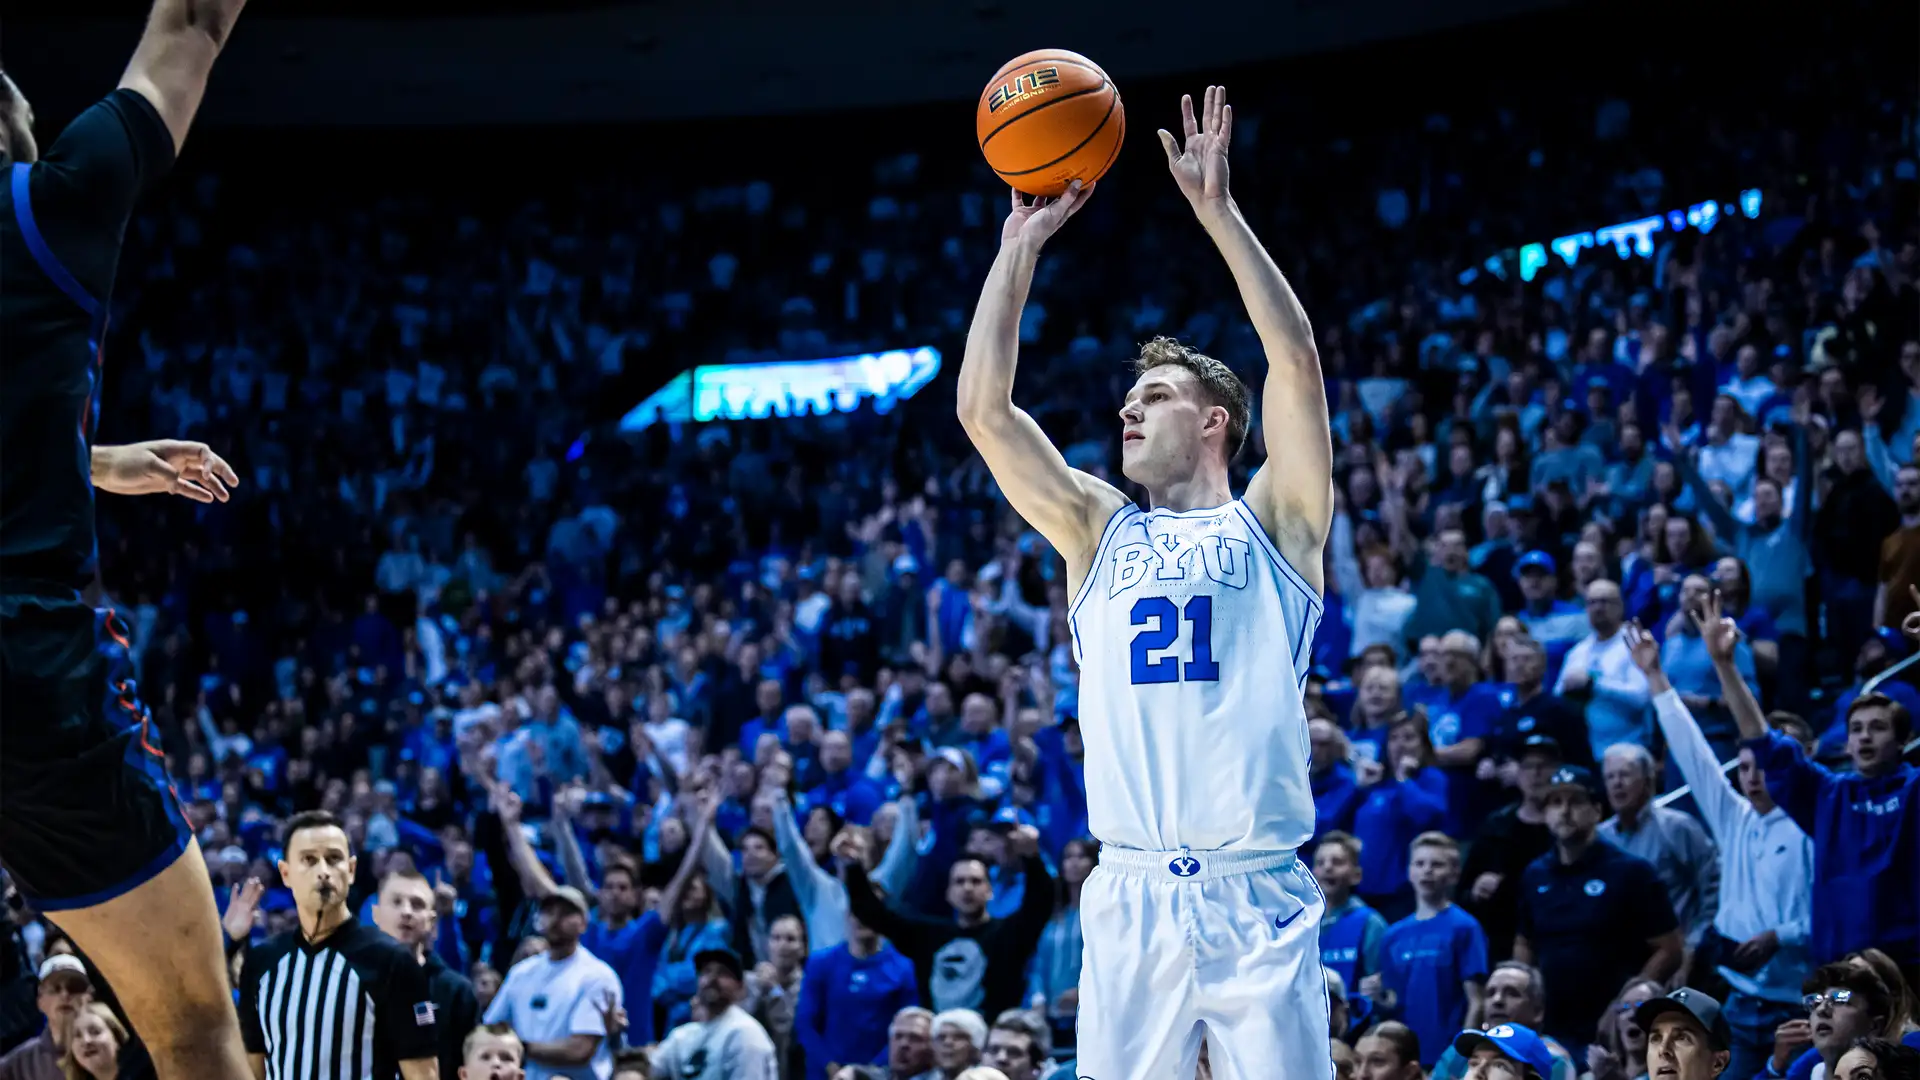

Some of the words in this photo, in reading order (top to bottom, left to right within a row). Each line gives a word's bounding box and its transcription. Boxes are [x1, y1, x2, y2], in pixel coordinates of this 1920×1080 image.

[988, 66, 1060, 113] ELITE
[1109, 533, 1250, 600] BYU
[1130, 595, 1219, 685] 21
[1173, 859, 1195, 875] Y
